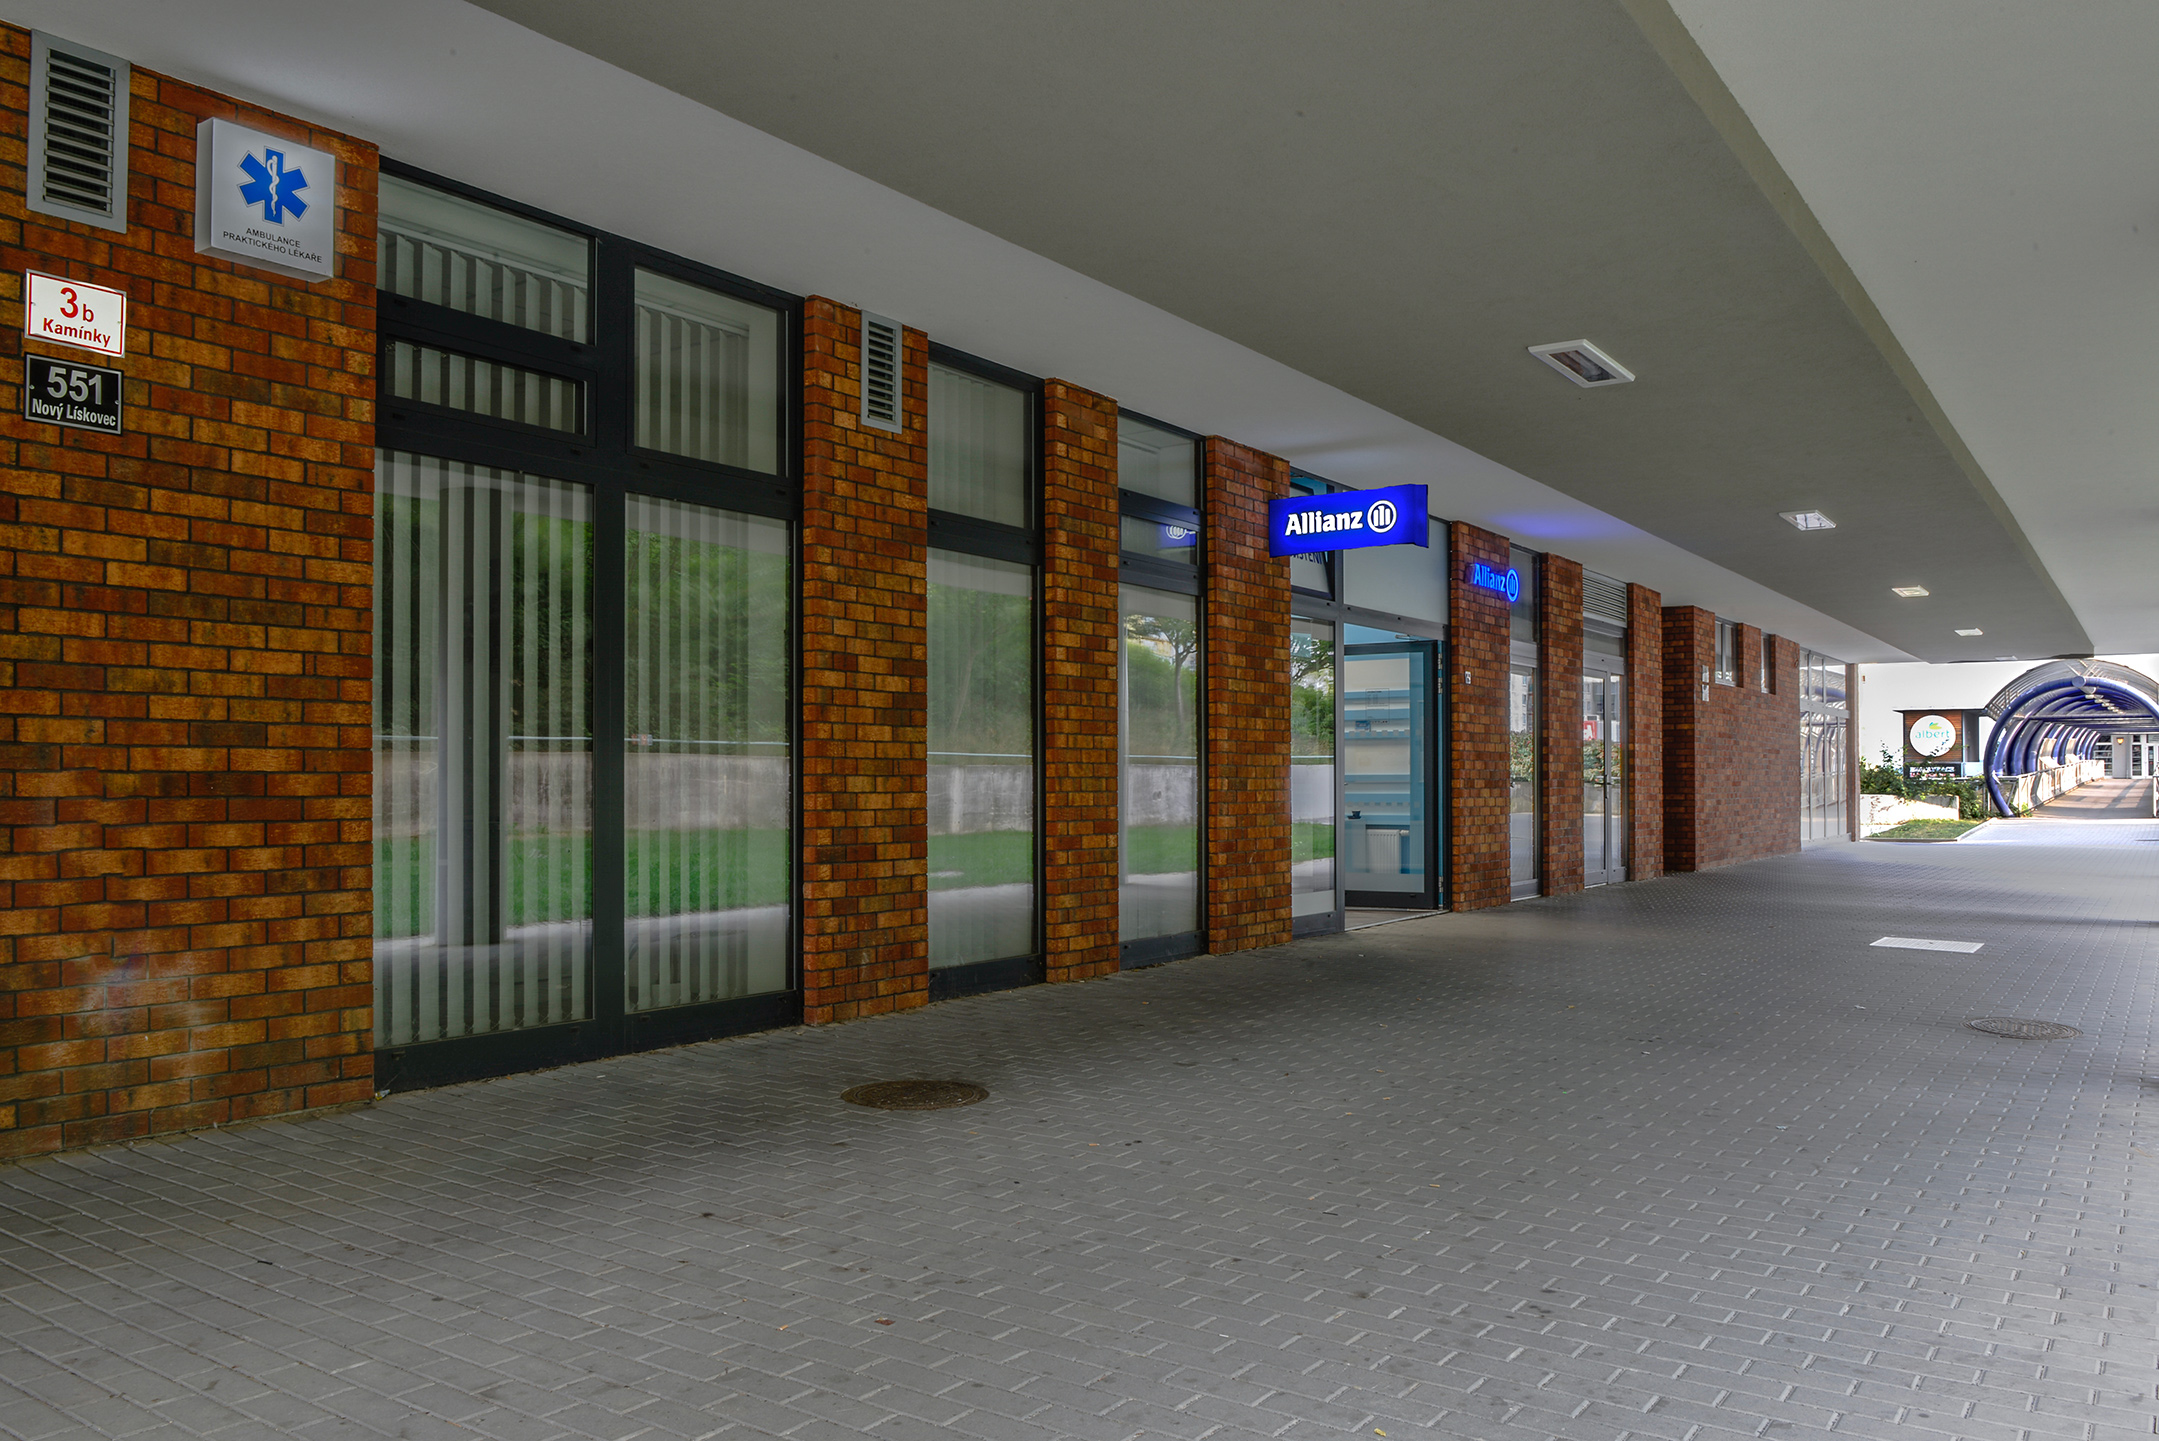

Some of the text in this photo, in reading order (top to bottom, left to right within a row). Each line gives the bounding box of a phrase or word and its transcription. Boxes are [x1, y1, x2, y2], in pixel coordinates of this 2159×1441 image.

[223, 231, 322, 263] PRAKTICKÉHO LÉKAŘE
[246, 228, 300, 248] AMBULANCE
[43, 317, 111, 347] Kamínky
[47, 366, 102, 405] 551
[32, 398, 116, 426] Nový Lískovec
[1285, 510, 1363, 536] Allianz
[1474, 563, 1506, 592] Allianz
[1915, 730, 1949, 739] albert
